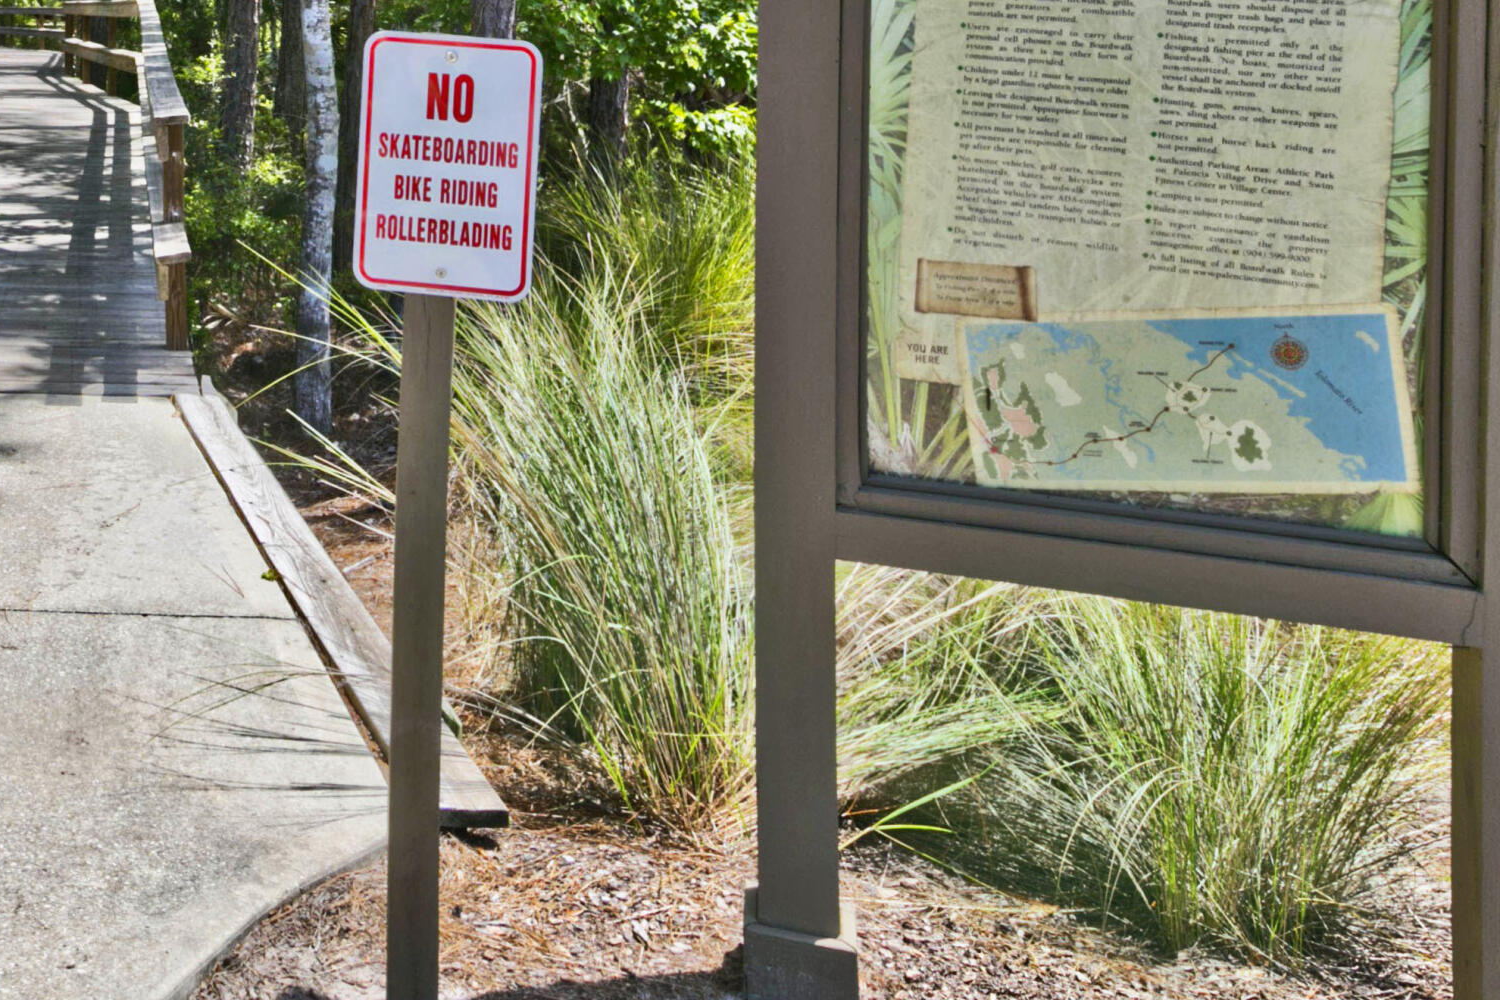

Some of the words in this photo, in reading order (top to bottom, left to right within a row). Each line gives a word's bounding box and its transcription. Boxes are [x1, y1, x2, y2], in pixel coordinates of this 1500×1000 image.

[967, 9, 1004, 18] materials
[968, 1, 994, 9] power
[1005, 2, 1050, 12] generators
[1082, 6, 1135, 17] combustible
[1166, 8, 1187, 16] trash
[1205, 12, 1232, 21] proper
[1238, 13, 1259, 21] trash
[1264, 14, 1283, 24] bags
[1289, 16, 1304, 24] and
[1309, 17, 1331, 27] place
[1247, 3, 1275, 12] should
[1282, 5, 1313, 15] dispose
[966, 22, 990, 31] Users
[1015, 26, 1063, 37] encouraged
[1084, 32, 1106, 40] carry
[1113, 32, 1133, 41] their
[1165, 18, 1211, 30] designated
[1213, 22, 1235, 30] trash
[966, 32, 999, 42] personal
[1005, 35, 1018, 43] cell
[1023, 36, 1051, 46] phones
[1089, 41, 1132, 51] Boardwalk
[1164, 43, 1209, 54] designated
[1213, 46, 1242, 56] fishing
[1246, 49, 1263, 58] pier
[1297, 52, 1313, 60] end
[1329, 54, 1342, 62] the
[1162, 73, 1187, 81] vessel
[1190, 75, 1210, 83] shall
[1226, 78, 1265, 88] anchored
[1280, 82, 1312, 91] docked
[1315, 85, 1340, 94] on/off
[426, 72, 475, 123] NO
[963, 88, 993, 99] Leaving
[995, 91, 1006, 99] the
[1010, 92, 1052, 104] designated
[1055, 96, 1097, 107] Boardwalk
[1101, 101, 1129, 111] system
[378, 132, 519, 169] SKATEBOARDING
[973, 142, 991, 151] after
[994, 144, 1012, 153] their
[1158, 131, 1188, 141] Horses
[1197, 135, 1213, 143] and
[1222, 137, 1246, 146] horse
[1255, 140, 1276, 149] back
[1286, 143, 1312, 153] riding
[1157, 156, 1203, 167] Authorized
[1208, 160, 1240, 171] Parking
[1277, 167, 1309, 177] Athletic
[1314, 170, 1334, 179] Park
[1173, 167, 1209, 178] Palencia
[1217, 172, 1245, 183] Village
[1253, 175, 1277, 184] Drive
[1285, 178, 1301, 187] and
[394, 174, 432, 202] BIKE
[440, 178, 498, 208] RIDING
[1154, 190, 1191, 202] Camping
[376, 213, 512, 251] ROLLERBLADING
[907, 343, 926, 353] YOU
[930, 345, 949, 355] ARE
[915, 354, 940, 365] HERE
